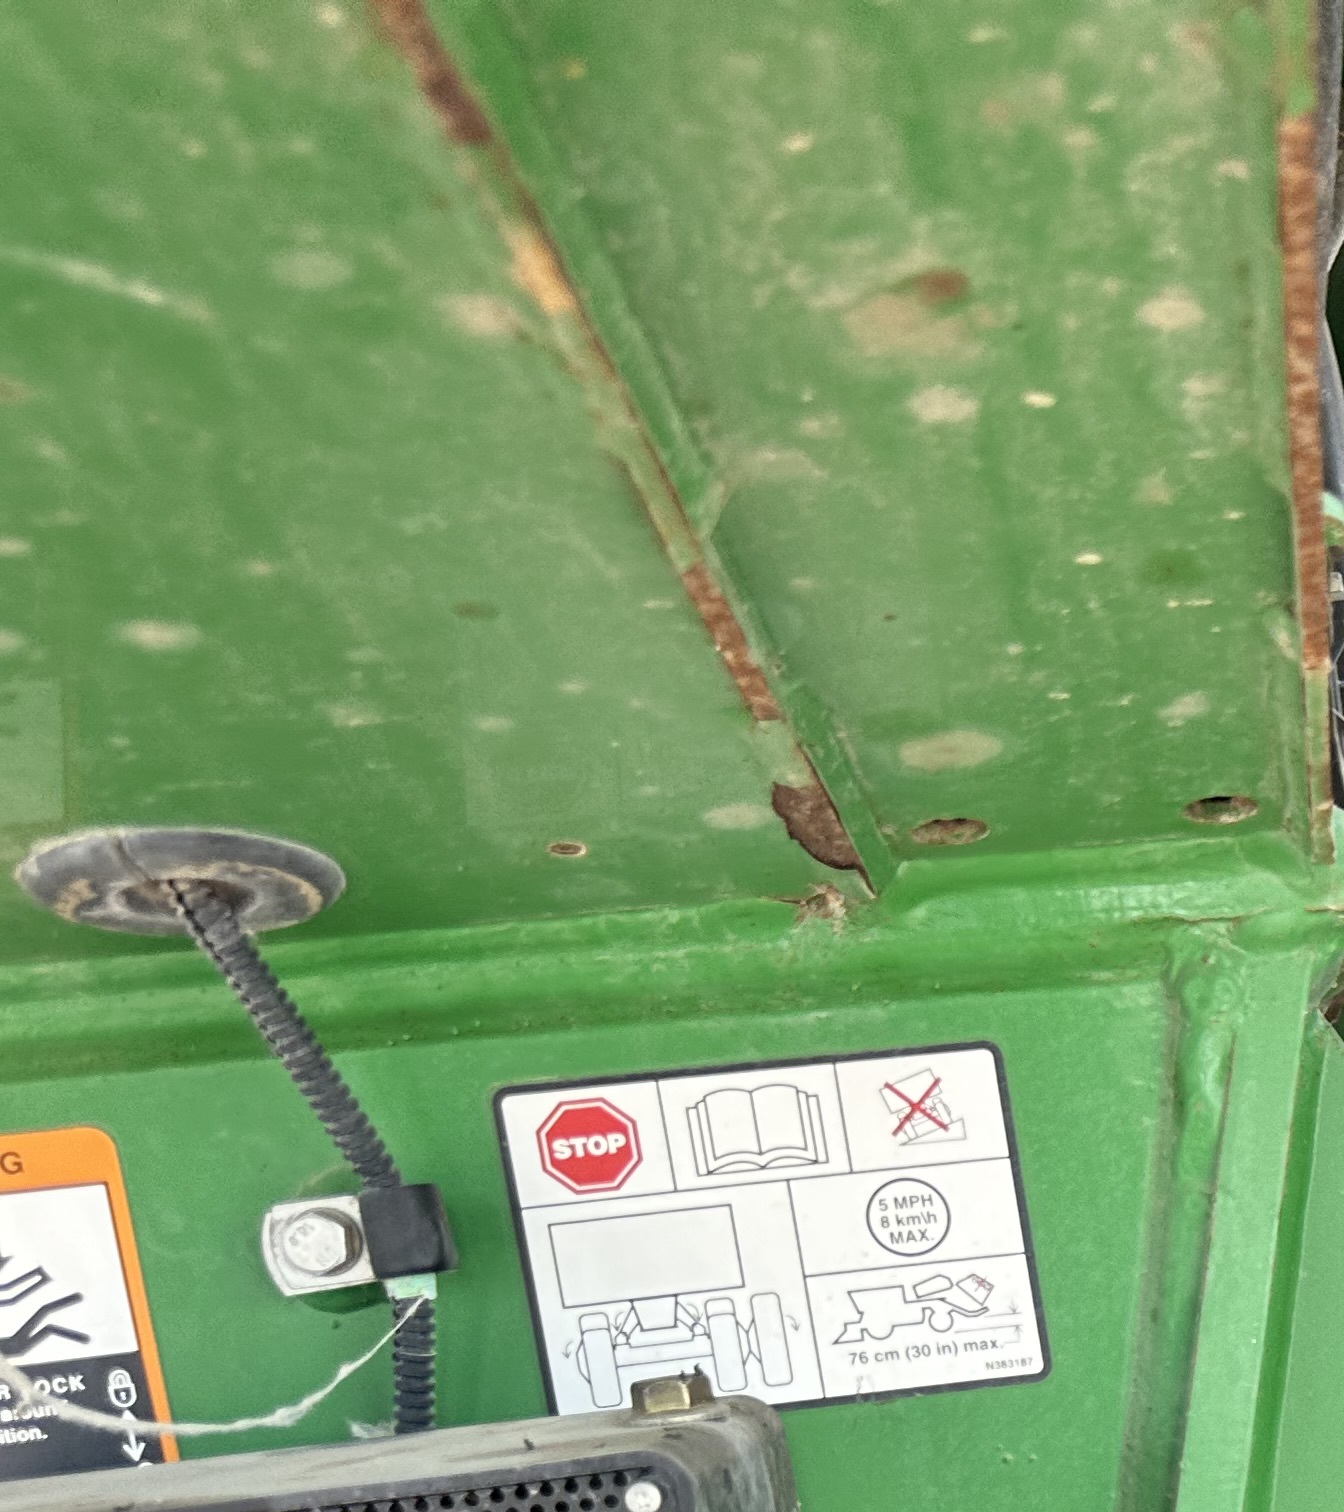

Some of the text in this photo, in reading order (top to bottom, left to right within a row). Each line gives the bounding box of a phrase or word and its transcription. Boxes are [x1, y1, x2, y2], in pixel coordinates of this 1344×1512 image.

[552, 1133, 626, 1160] STOP
[879, 1194, 933, 1211] 5 MPH
[881, 1216, 890, 1229] 8
[890, 1228, 935, 1244] MAX.
[849, 1351, 869, 1365] 76
[875, 1350, 900, 1362] cm
[905, 1343, 932, 1361] (30
[936, 1341, 958, 1356] in)
[985, 1357, 1033, 1370] N383187
